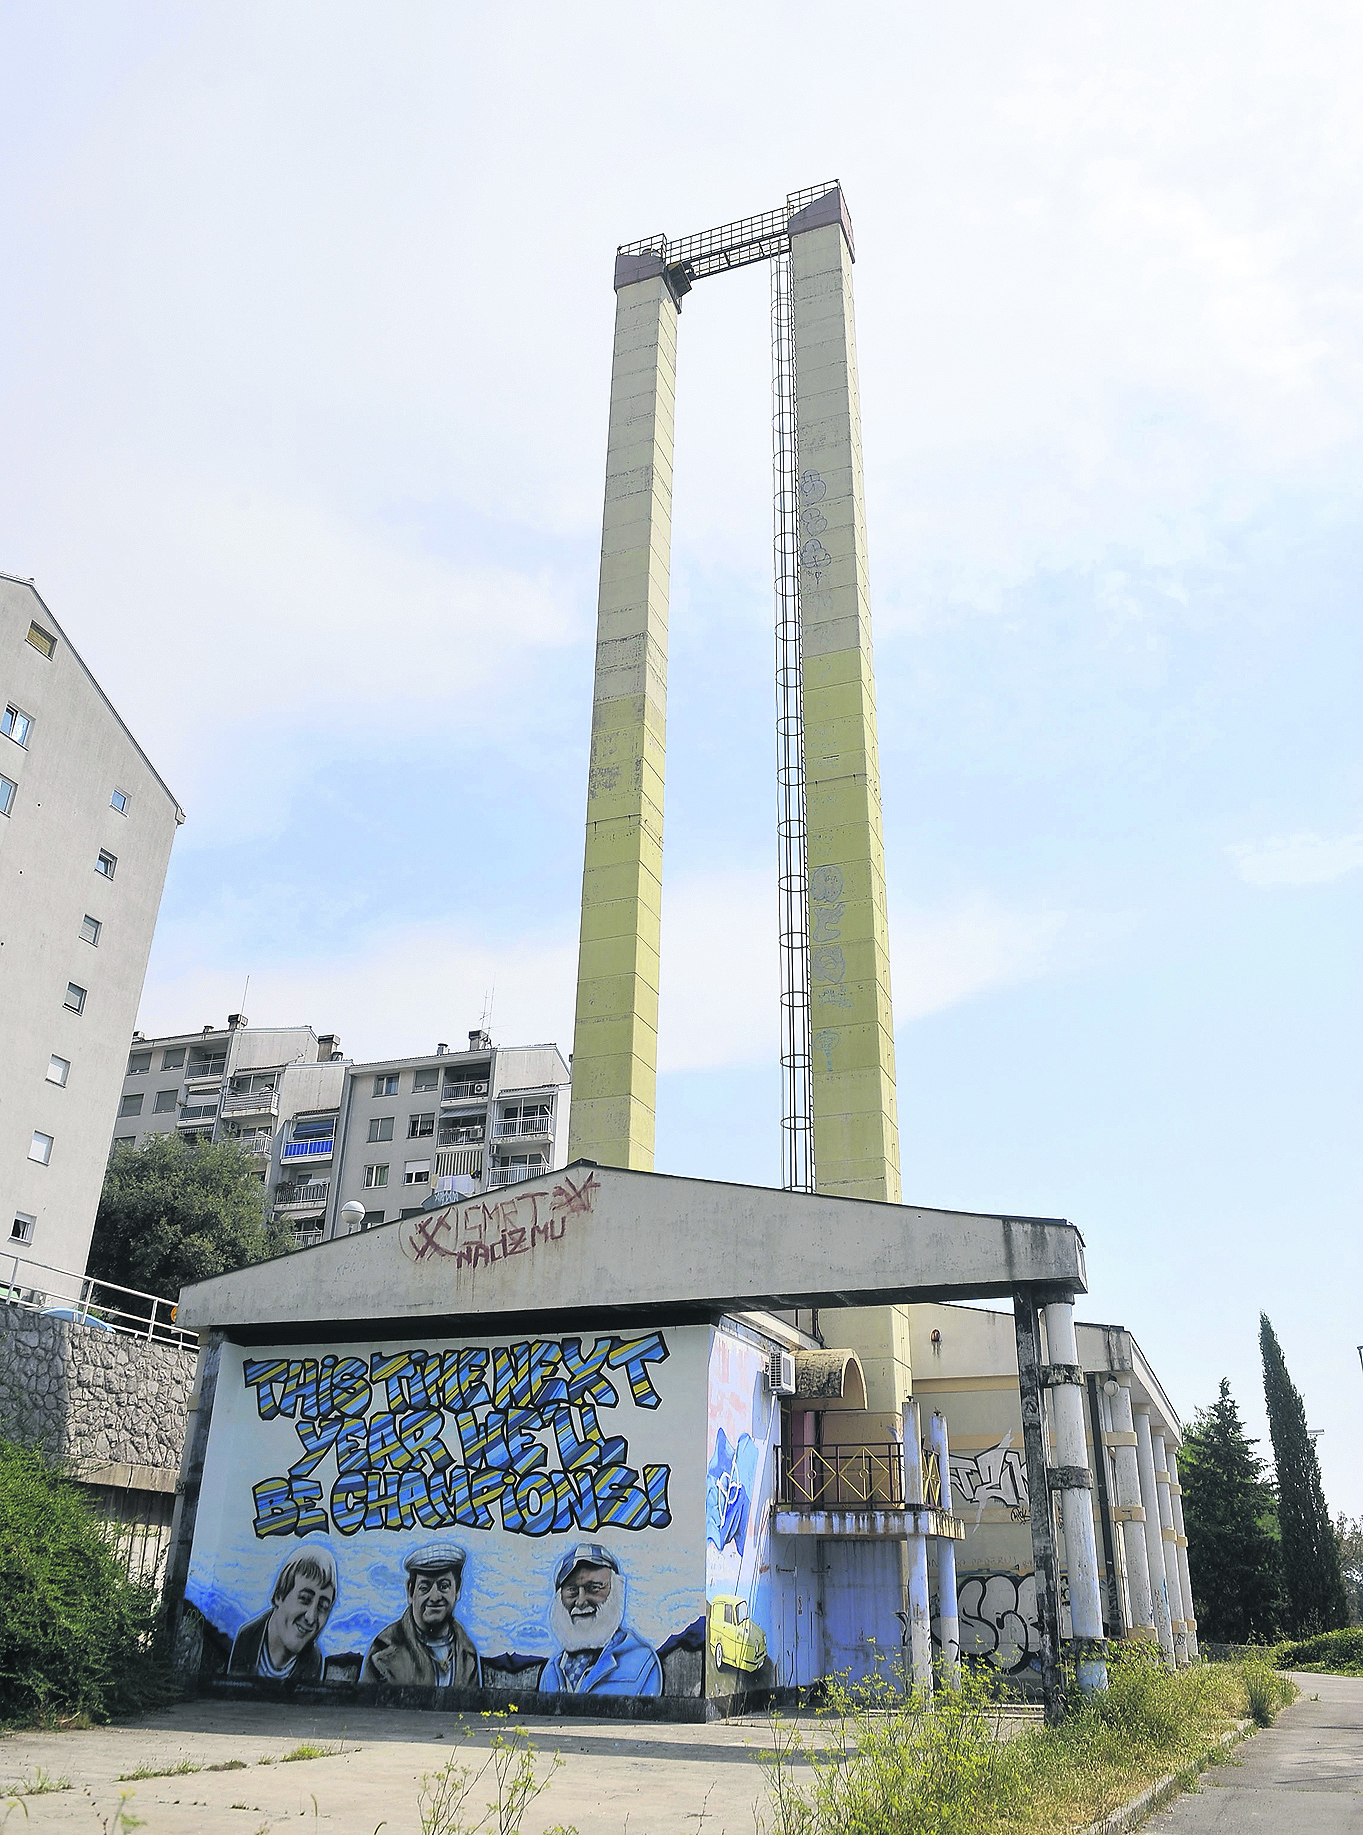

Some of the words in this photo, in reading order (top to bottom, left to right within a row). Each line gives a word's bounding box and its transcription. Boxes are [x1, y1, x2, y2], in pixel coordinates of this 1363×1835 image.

[491, 1330, 670, 1410] NEXT
[288, 1408, 456, 1478] YEAR
[252, 1475, 330, 1539] BE
